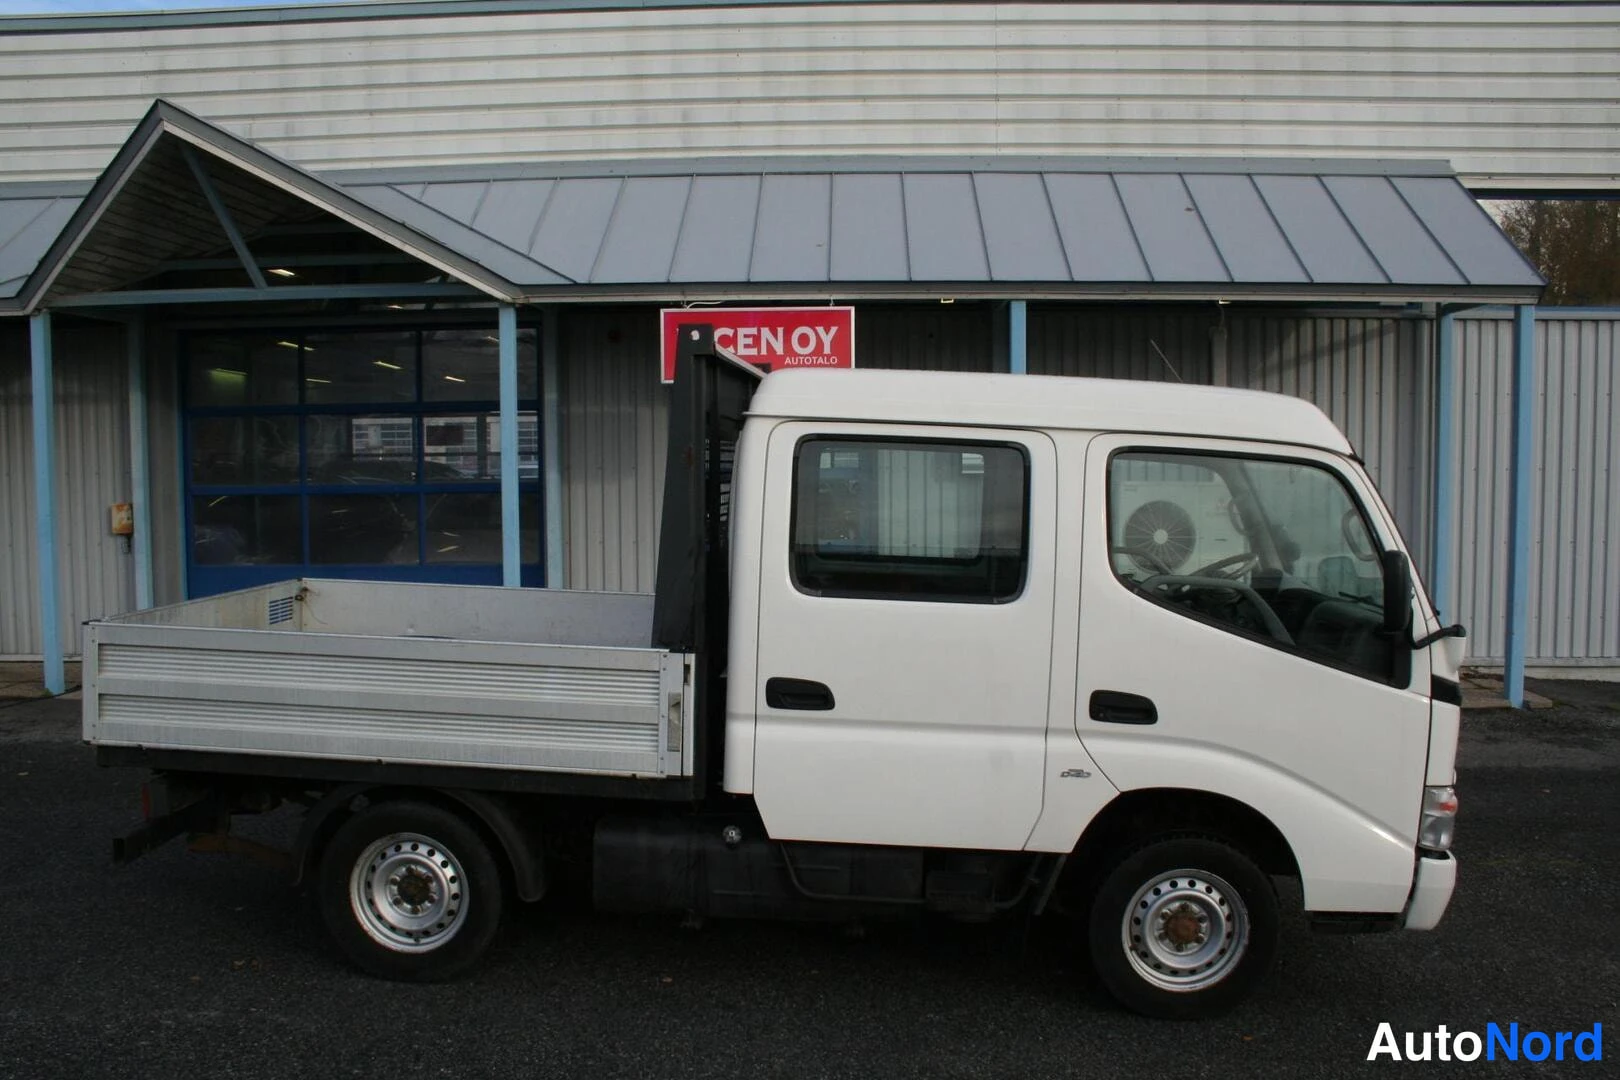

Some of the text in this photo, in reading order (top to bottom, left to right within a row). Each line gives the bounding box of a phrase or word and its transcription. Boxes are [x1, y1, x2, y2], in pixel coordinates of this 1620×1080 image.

[676, 325, 839, 355] CEN OY
[784, 356, 838, 365] AUTOTALO
